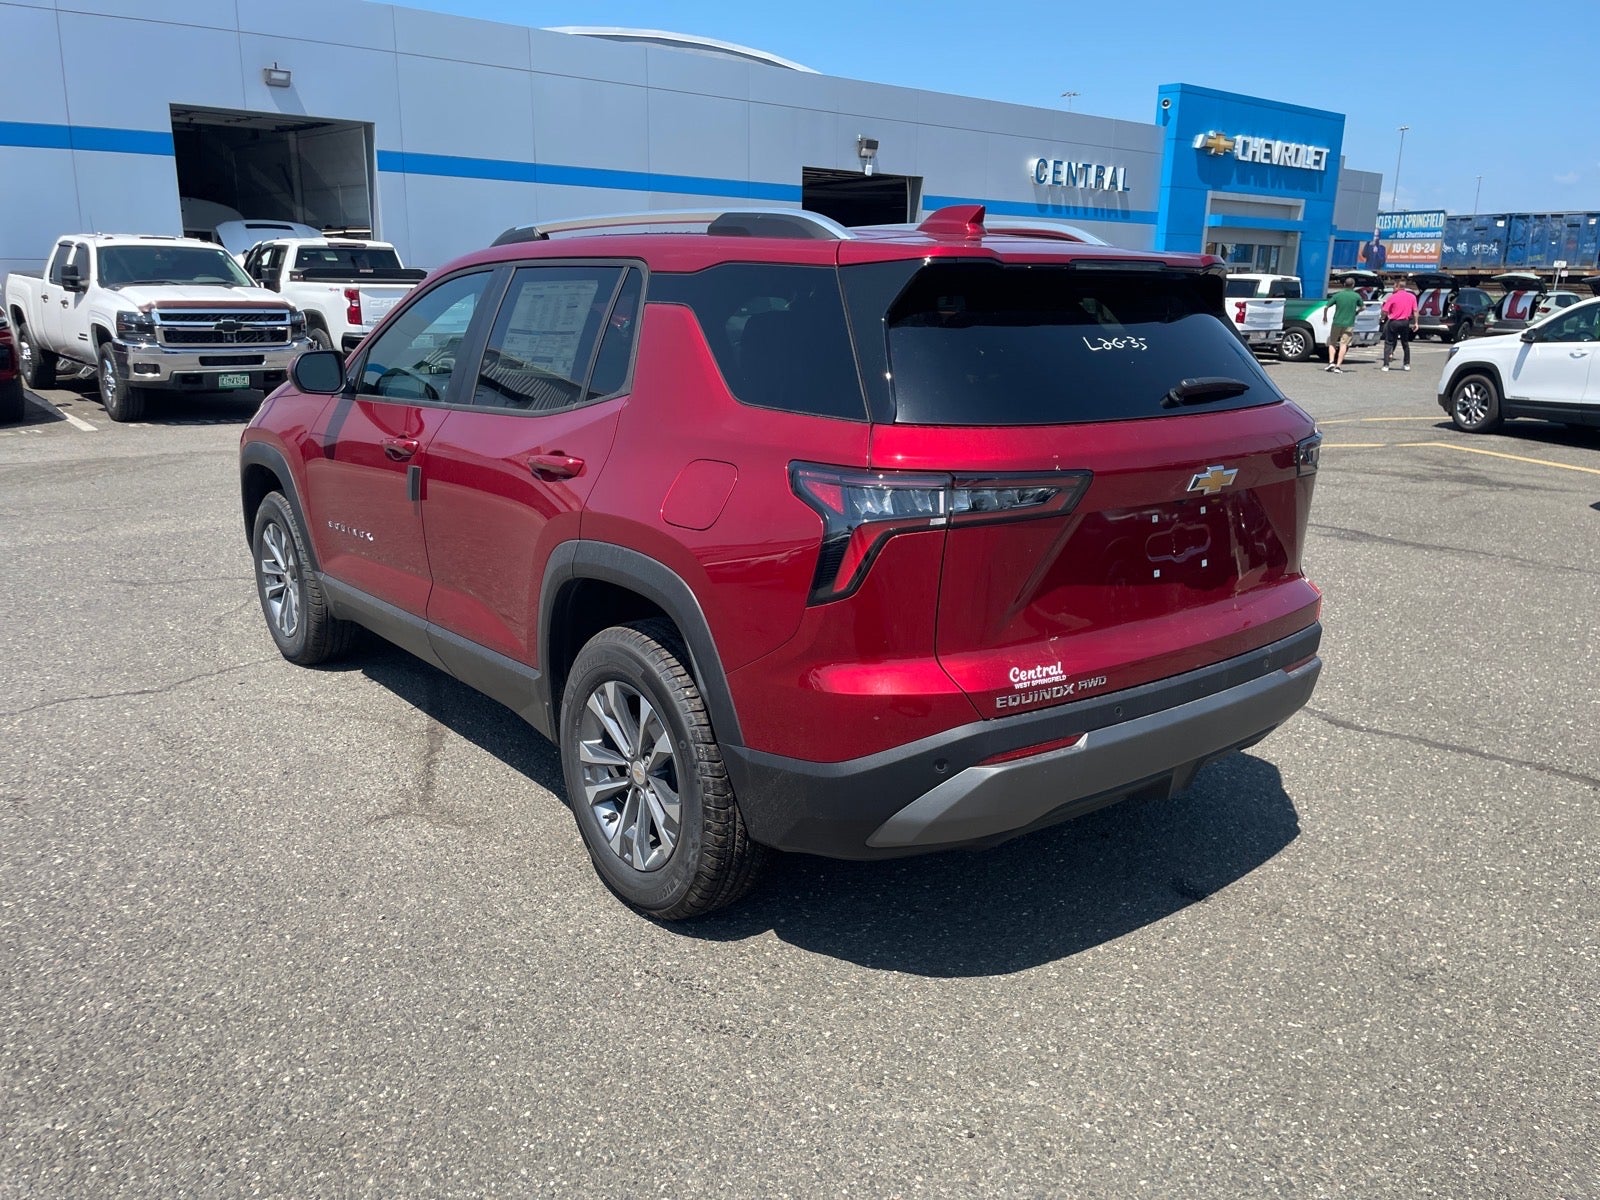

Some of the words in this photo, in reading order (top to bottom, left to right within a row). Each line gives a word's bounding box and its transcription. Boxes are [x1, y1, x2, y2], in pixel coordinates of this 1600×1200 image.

[1236, 135, 1330, 171] CHEVROLET
[1032, 158, 1131, 192] CENTRAL
[1404, 212, 1444, 229] SPRINGFIELD
[1397, 231, 1405, 239] Ted
[1391, 242, 1412, 254] JULY
[1413, 242, 1436, 254] 19-24
[1420, 288, 1441, 316] A
[1505, 290, 1528, 319] L
[1009, 661, 1064, 682] Central
[1014, 681, 1031, 690] WEST
[1031, 674, 1067, 687] SPRINGFIELD
[995, 683, 1075, 709] EQUINOX
[1077, 675, 1107, 691] AWD
